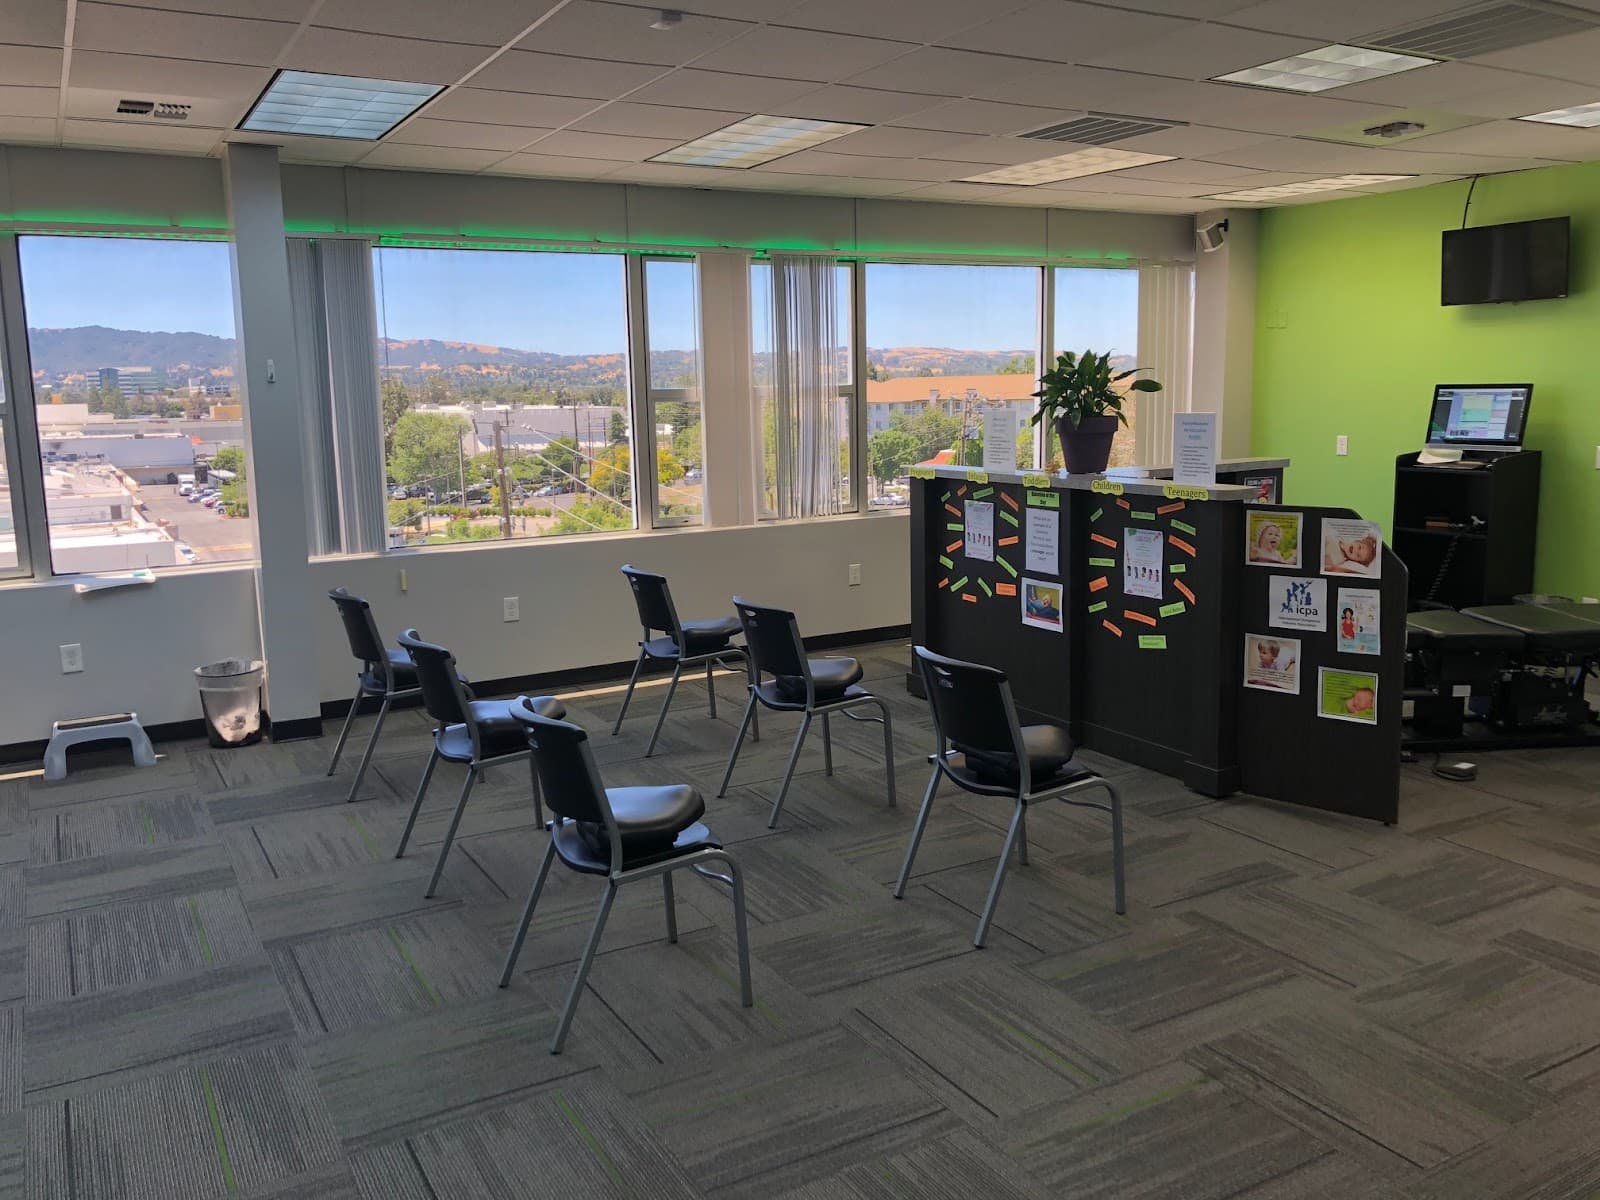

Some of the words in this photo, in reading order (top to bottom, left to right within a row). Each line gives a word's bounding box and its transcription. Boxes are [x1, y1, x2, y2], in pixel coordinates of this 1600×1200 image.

[1024, 476, 1049, 486] Toddlers
[1093, 480, 1121, 491] Children
[1167, 486, 1206, 498] Teenagers
[1296, 605, 1318, 617] icpa
